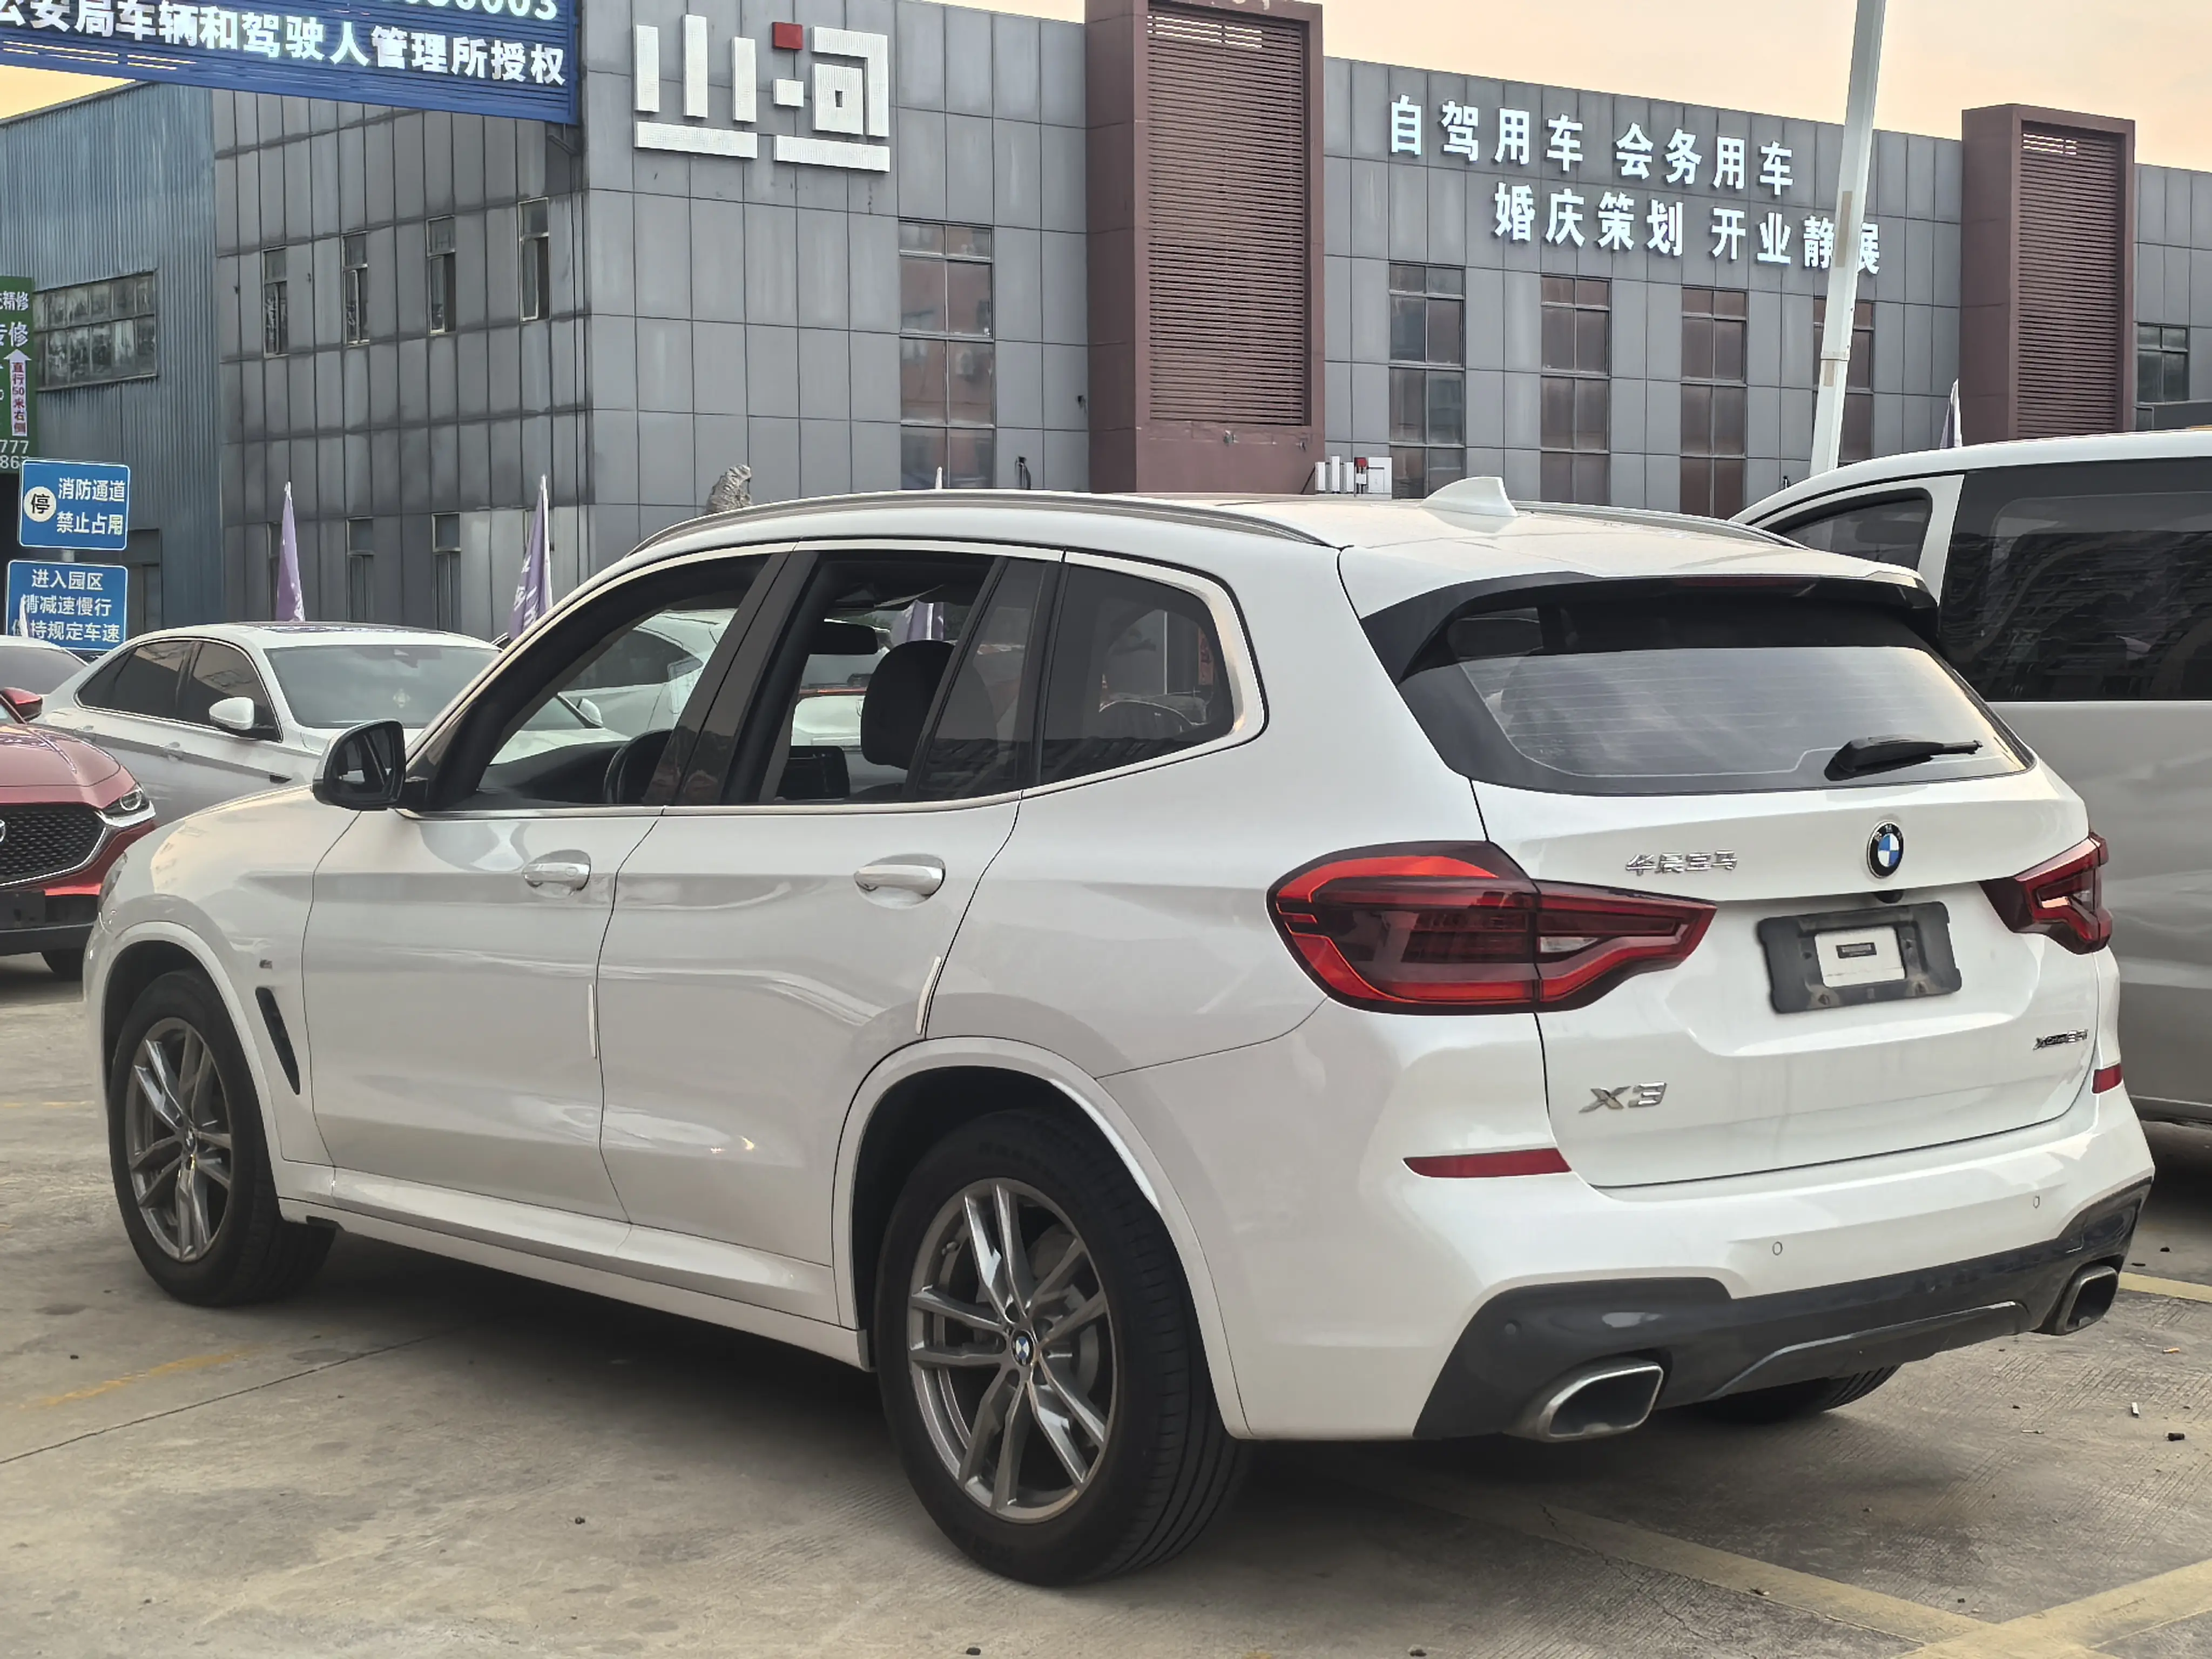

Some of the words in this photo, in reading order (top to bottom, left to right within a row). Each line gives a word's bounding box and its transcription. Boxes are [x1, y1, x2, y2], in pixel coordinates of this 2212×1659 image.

[1390, 94, 1584, 172] 自驾用车
[1615, 122, 1794, 196] 会务用车
[1493, 181, 1684, 257] 婚庆策划
[0, 291, 29, 311] 精修
[0, 455, 29, 469] 86
[58, 477, 125, 502] 消防通道
[30, 494, 51, 514] 停
[56, 511, 124, 536] 禁止占用
[31, 569, 104, 591] 进入园区
[1578, 1081, 1668, 1114] X3
